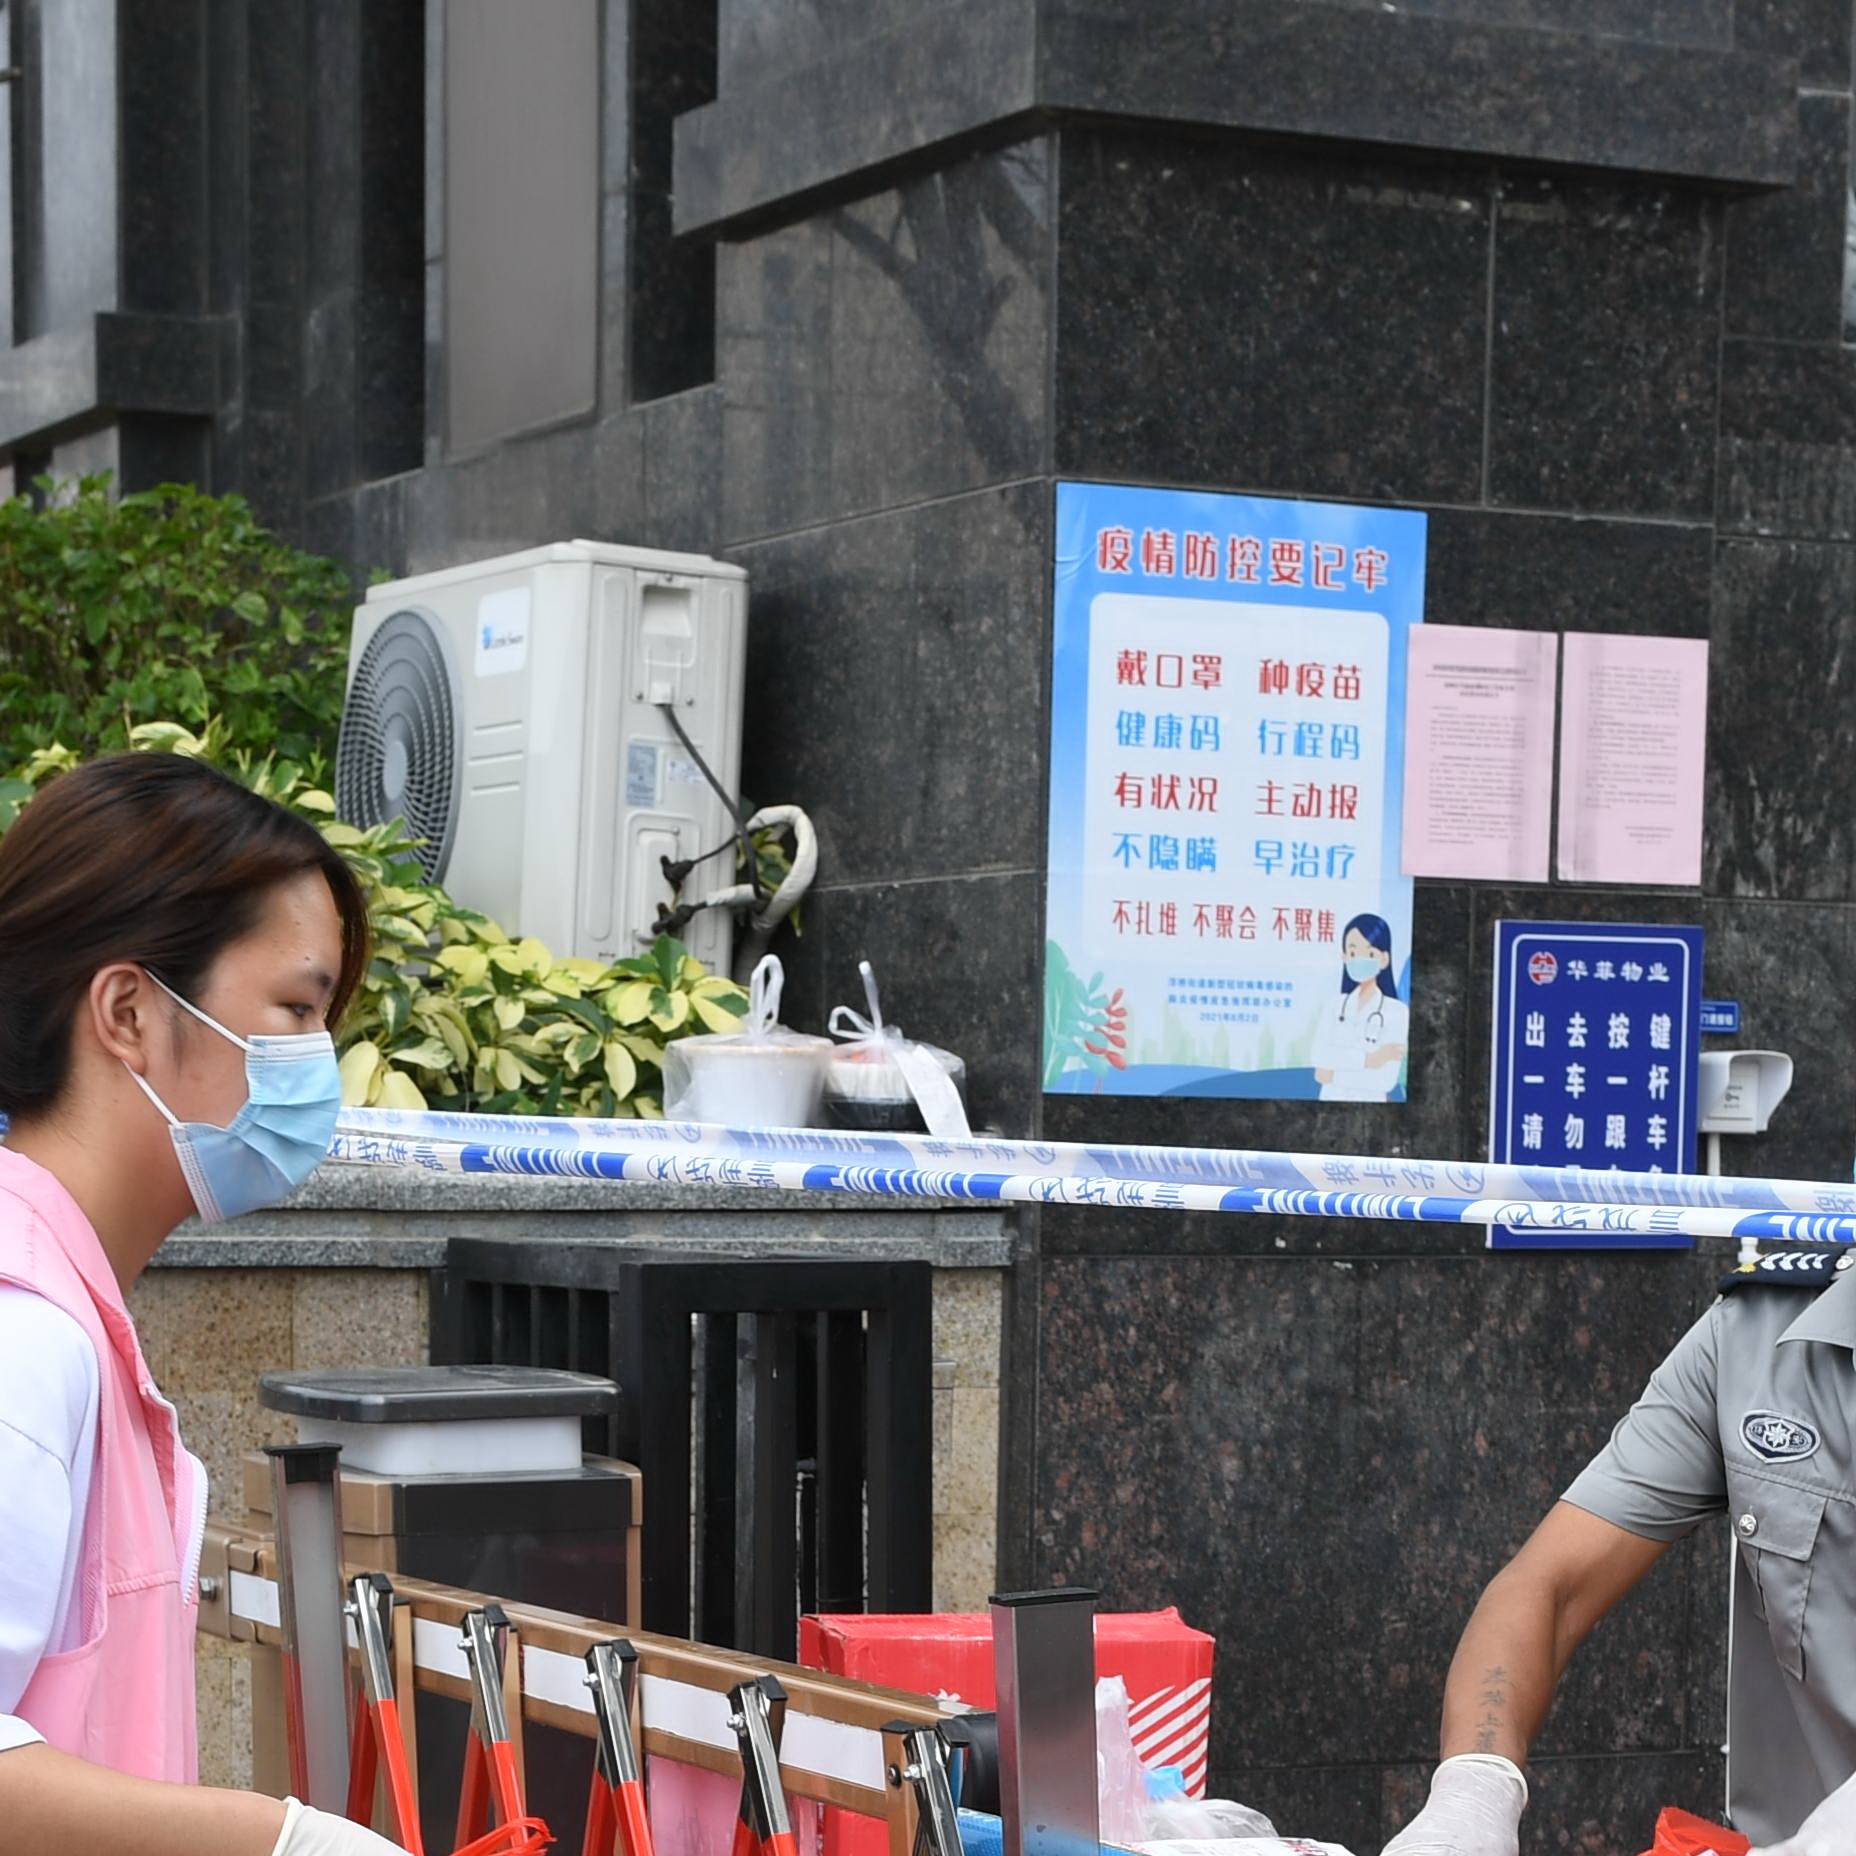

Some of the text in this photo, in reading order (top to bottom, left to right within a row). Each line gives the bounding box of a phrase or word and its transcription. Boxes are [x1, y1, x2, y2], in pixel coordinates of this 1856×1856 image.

[1096, 527, 1389, 592] 疫情防控要记牢
[1116, 650, 1362, 701] 戴口罩 种疫苗
[1115, 709, 1360, 761] 健康码 行程码
[1113, 772, 1358, 820] 有状况 主动报
[1111, 832, 1356, 879] 不隐瞒 早治疗
[1113, 900, 1336, 942] 不扎堆 不聚会 不聚集
[1525, 1011, 1672, 1050] 出去按键
[1523, 1062, 1670, 1101] 一车一杆
[1521, 1113, 1668, 1150] 请勿跟车
